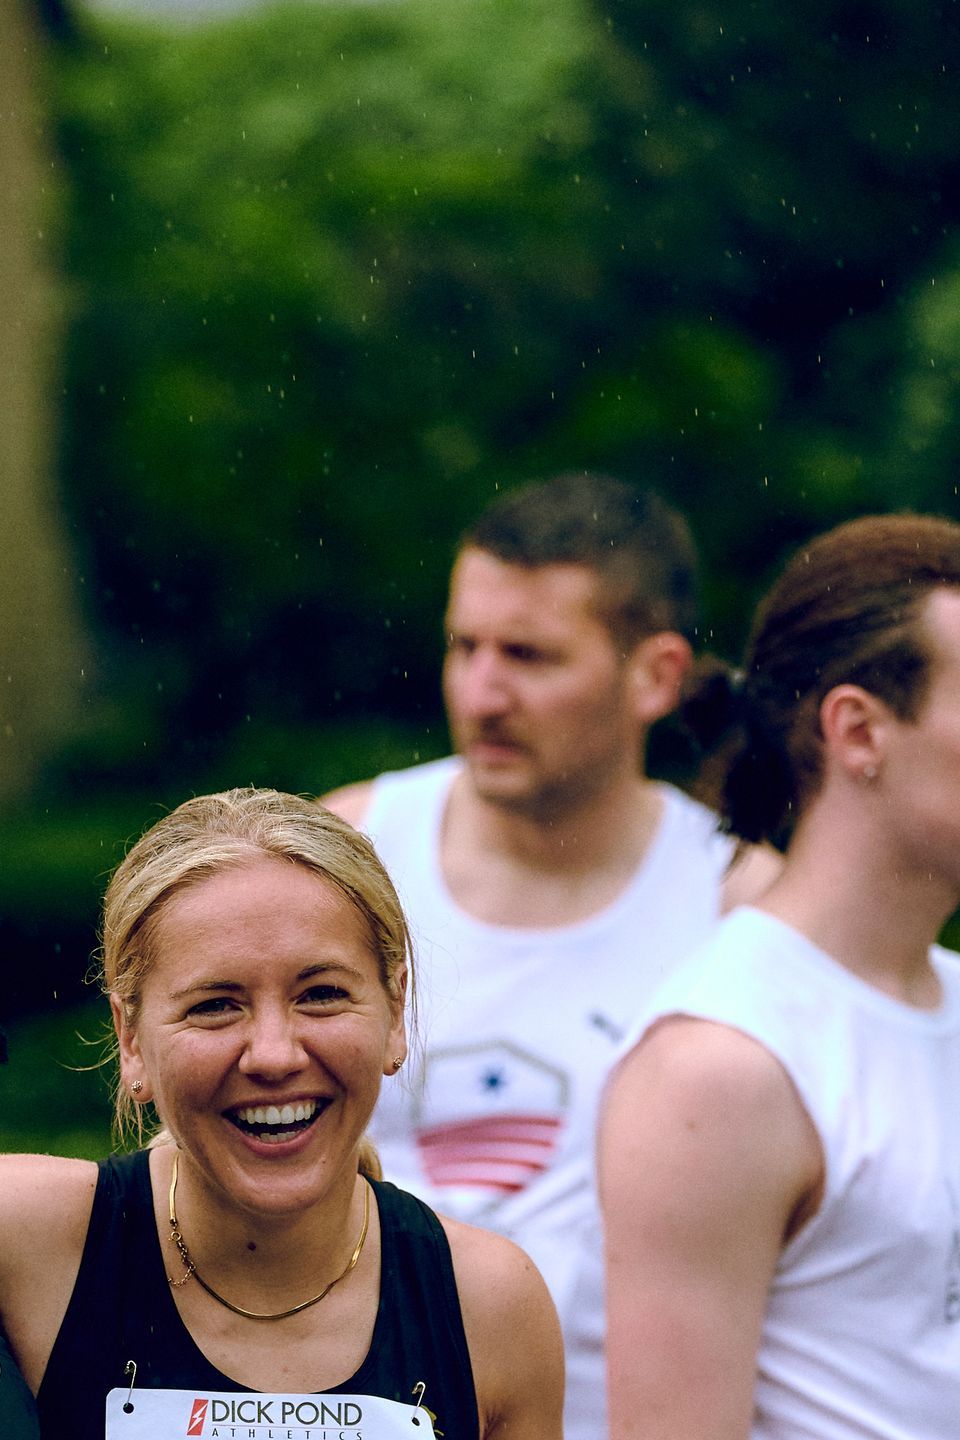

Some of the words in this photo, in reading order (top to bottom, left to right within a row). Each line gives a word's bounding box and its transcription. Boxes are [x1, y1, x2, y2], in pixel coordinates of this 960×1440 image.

[212, 1400, 274, 1424] DICK
[282, 1401, 362, 1426] POND
[212, 1428, 362, 1440] ATHLETICS
